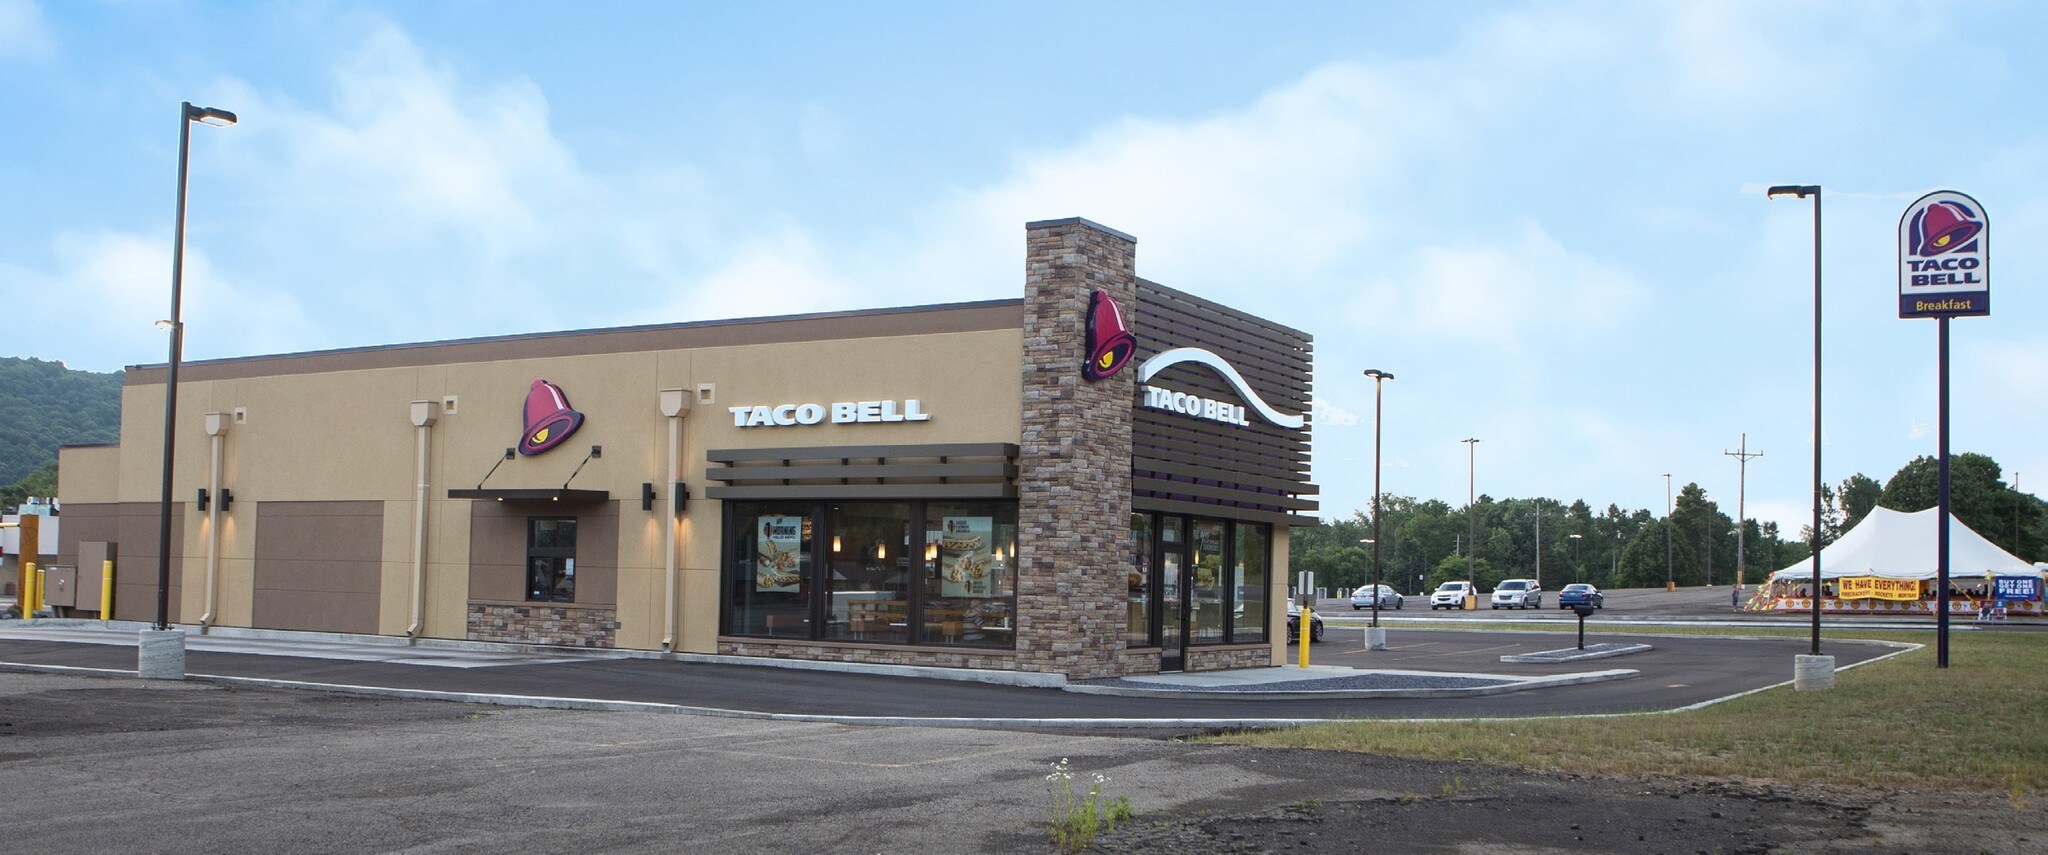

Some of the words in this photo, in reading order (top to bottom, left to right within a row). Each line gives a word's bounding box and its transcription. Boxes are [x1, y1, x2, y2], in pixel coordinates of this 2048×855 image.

[1906, 257, 1979, 272] TACO
[1911, 272, 1981, 287] BELL
[1916, 299, 1971, 311] Breakfast
[728, 403, 827, 428] TACO
[831, 399, 934, 424] BELL
[1141, 385, 1200, 417] TACO
[1201, 398, 1250, 427] BELL
[773, 526, 796, 535] MORNING
[1842, 580, 1852, 590] WE
[1855, 579, 1872, 588] HAVE
[1874, 579, 1916, 591] EVERYTHING!
